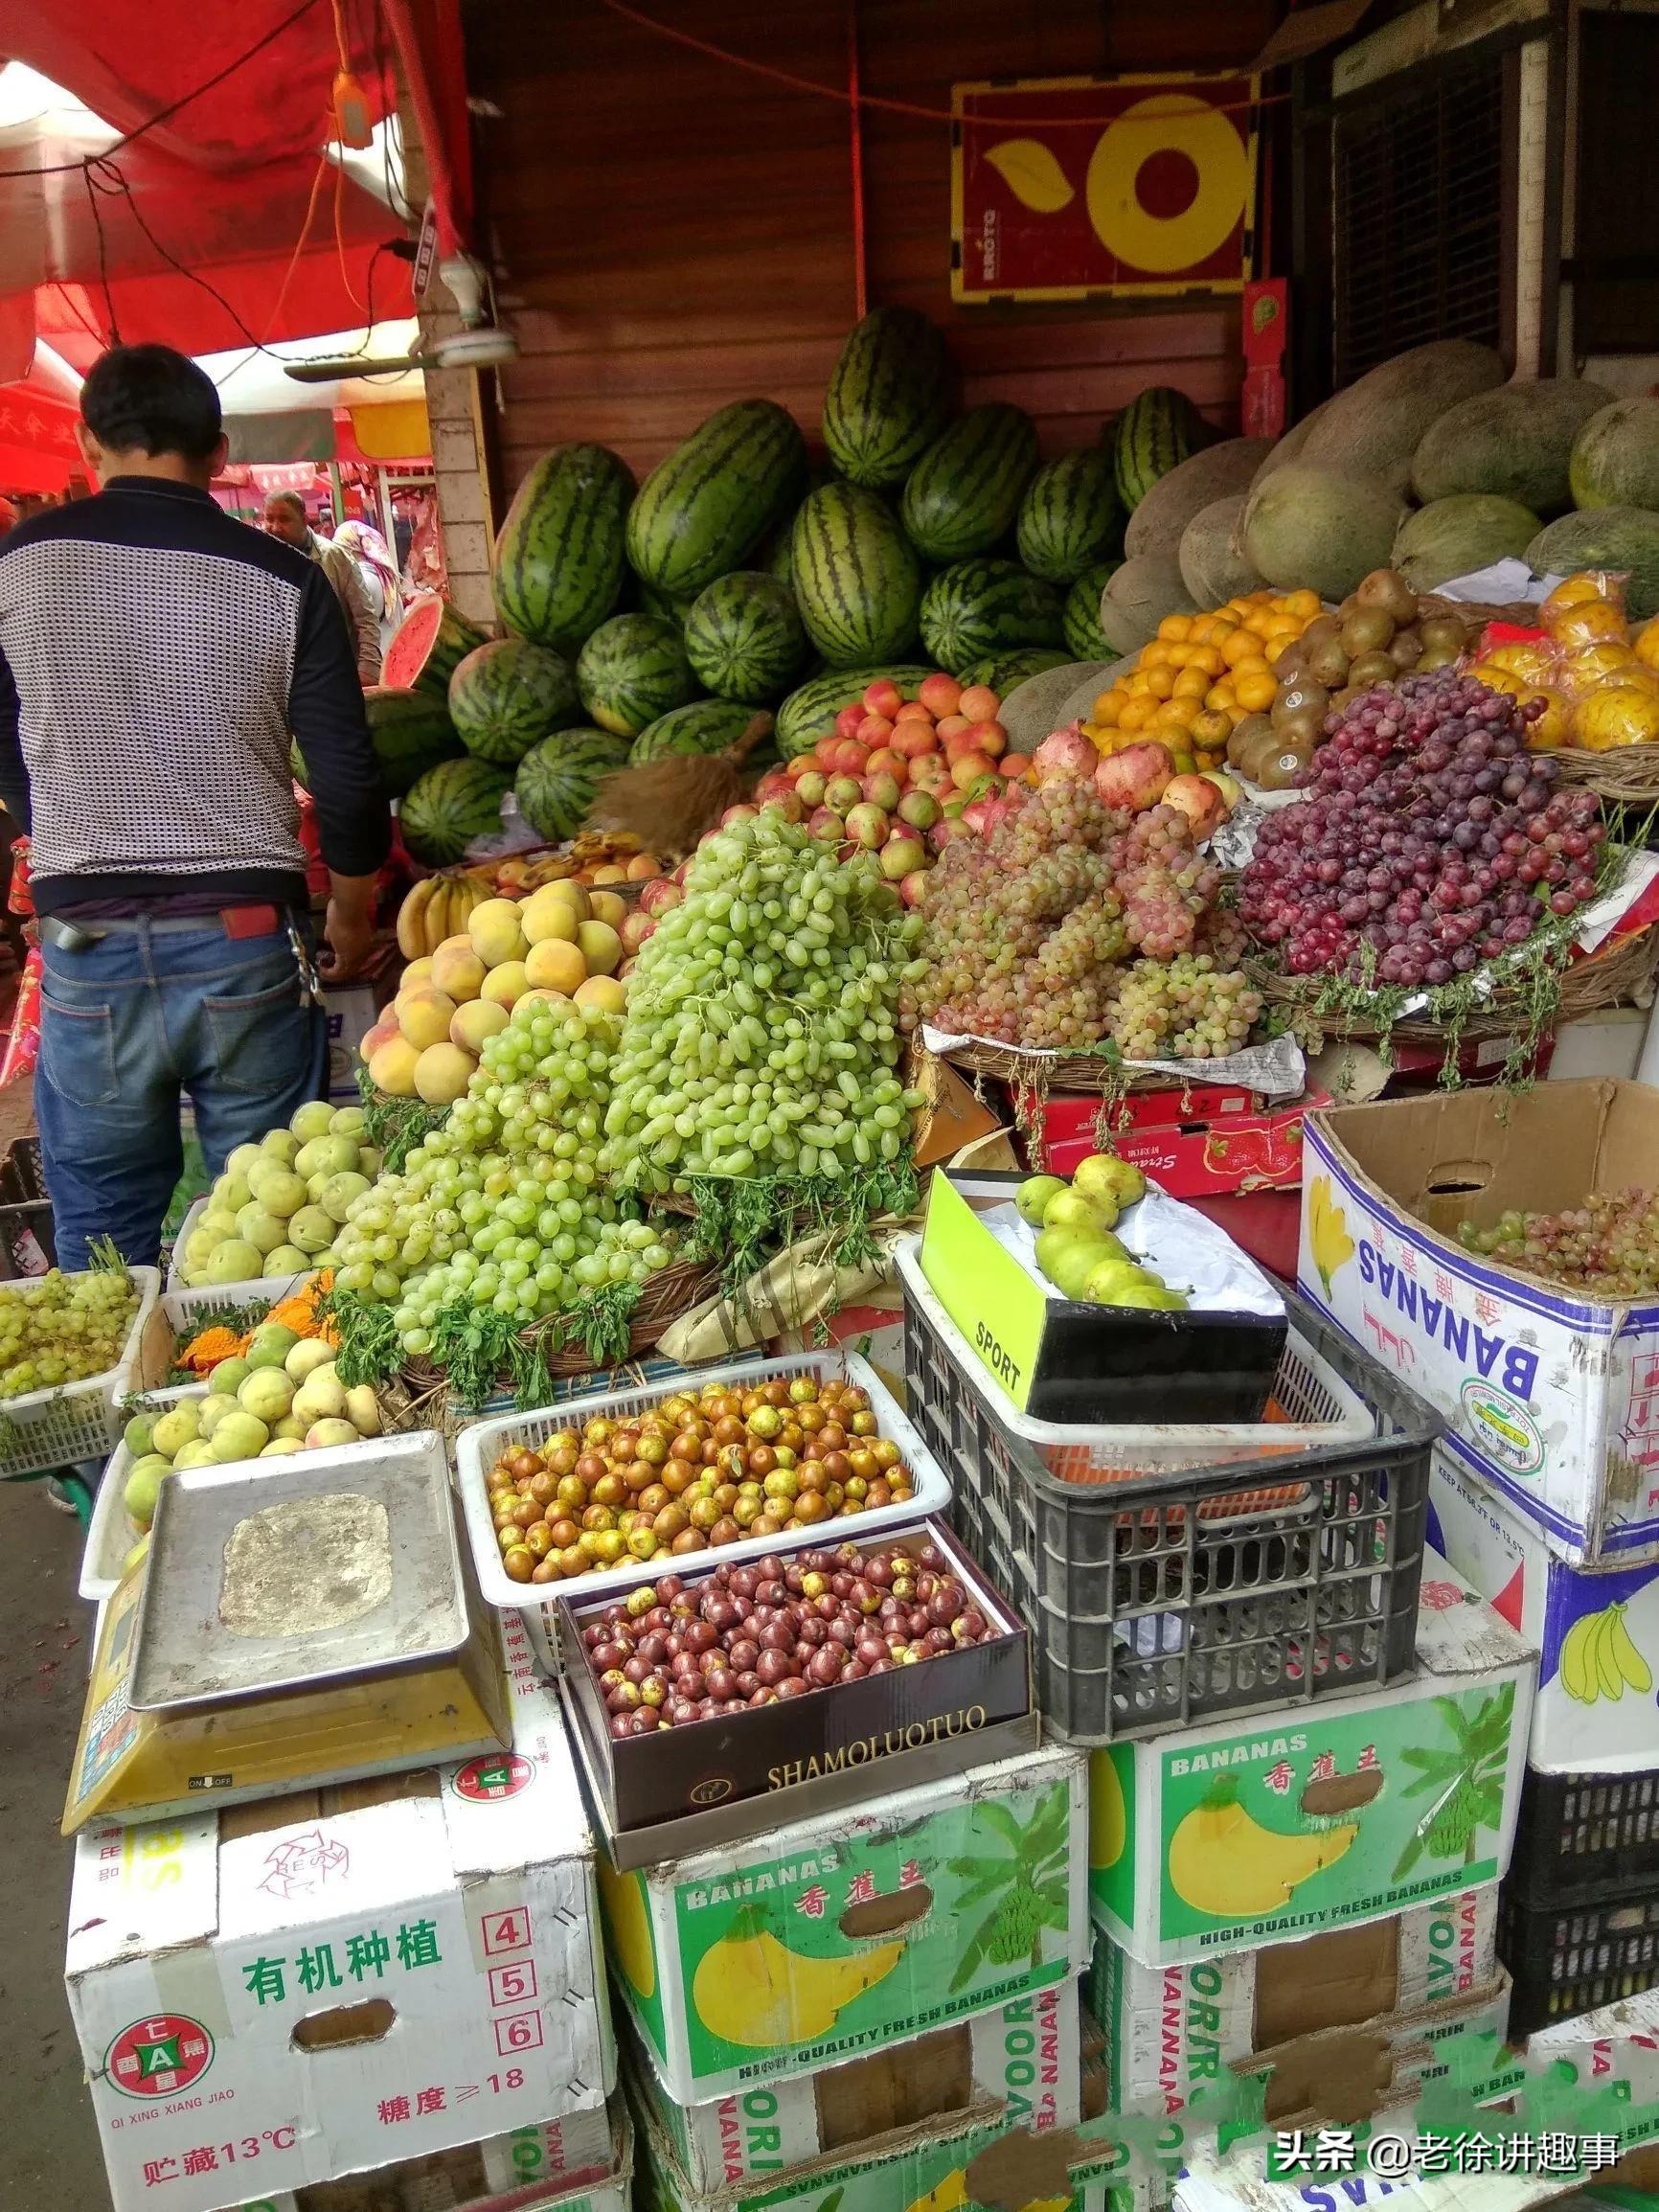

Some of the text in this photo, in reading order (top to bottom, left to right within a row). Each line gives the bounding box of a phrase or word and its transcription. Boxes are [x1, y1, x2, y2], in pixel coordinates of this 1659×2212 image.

[1359, 1239, 1539, 1402] BANANAS
[976, 1321, 1020, 1391] SPORT
[1439, 1465, 1456, 1487] KEEP
[1457, 1484, 1467, 1498] AT
[1489, 1517, 1501, 1533] OR
[767, 1705, 986, 1792] SHAMOLUOTUO
[1170, 1734, 1307, 1777] BANANAS
[1262, 1744, 1381, 1794] 香蕉王
[687, 1855, 840, 1910] BANANAS
[793, 1859, 926, 1918] 香蕉王
[1199, 1871, 1463, 1946] HIGH-QUALITY FRESH BANANAS
[242, 1919, 443, 2005] 有机种植
[883, 2010, 942, 2037] FRESH
[944, 1975, 1031, 2014] BANANAS
[148, 2046, 174, 2071] A
[111, 2088, 235, 2130] QI XING XIANG JIAO
